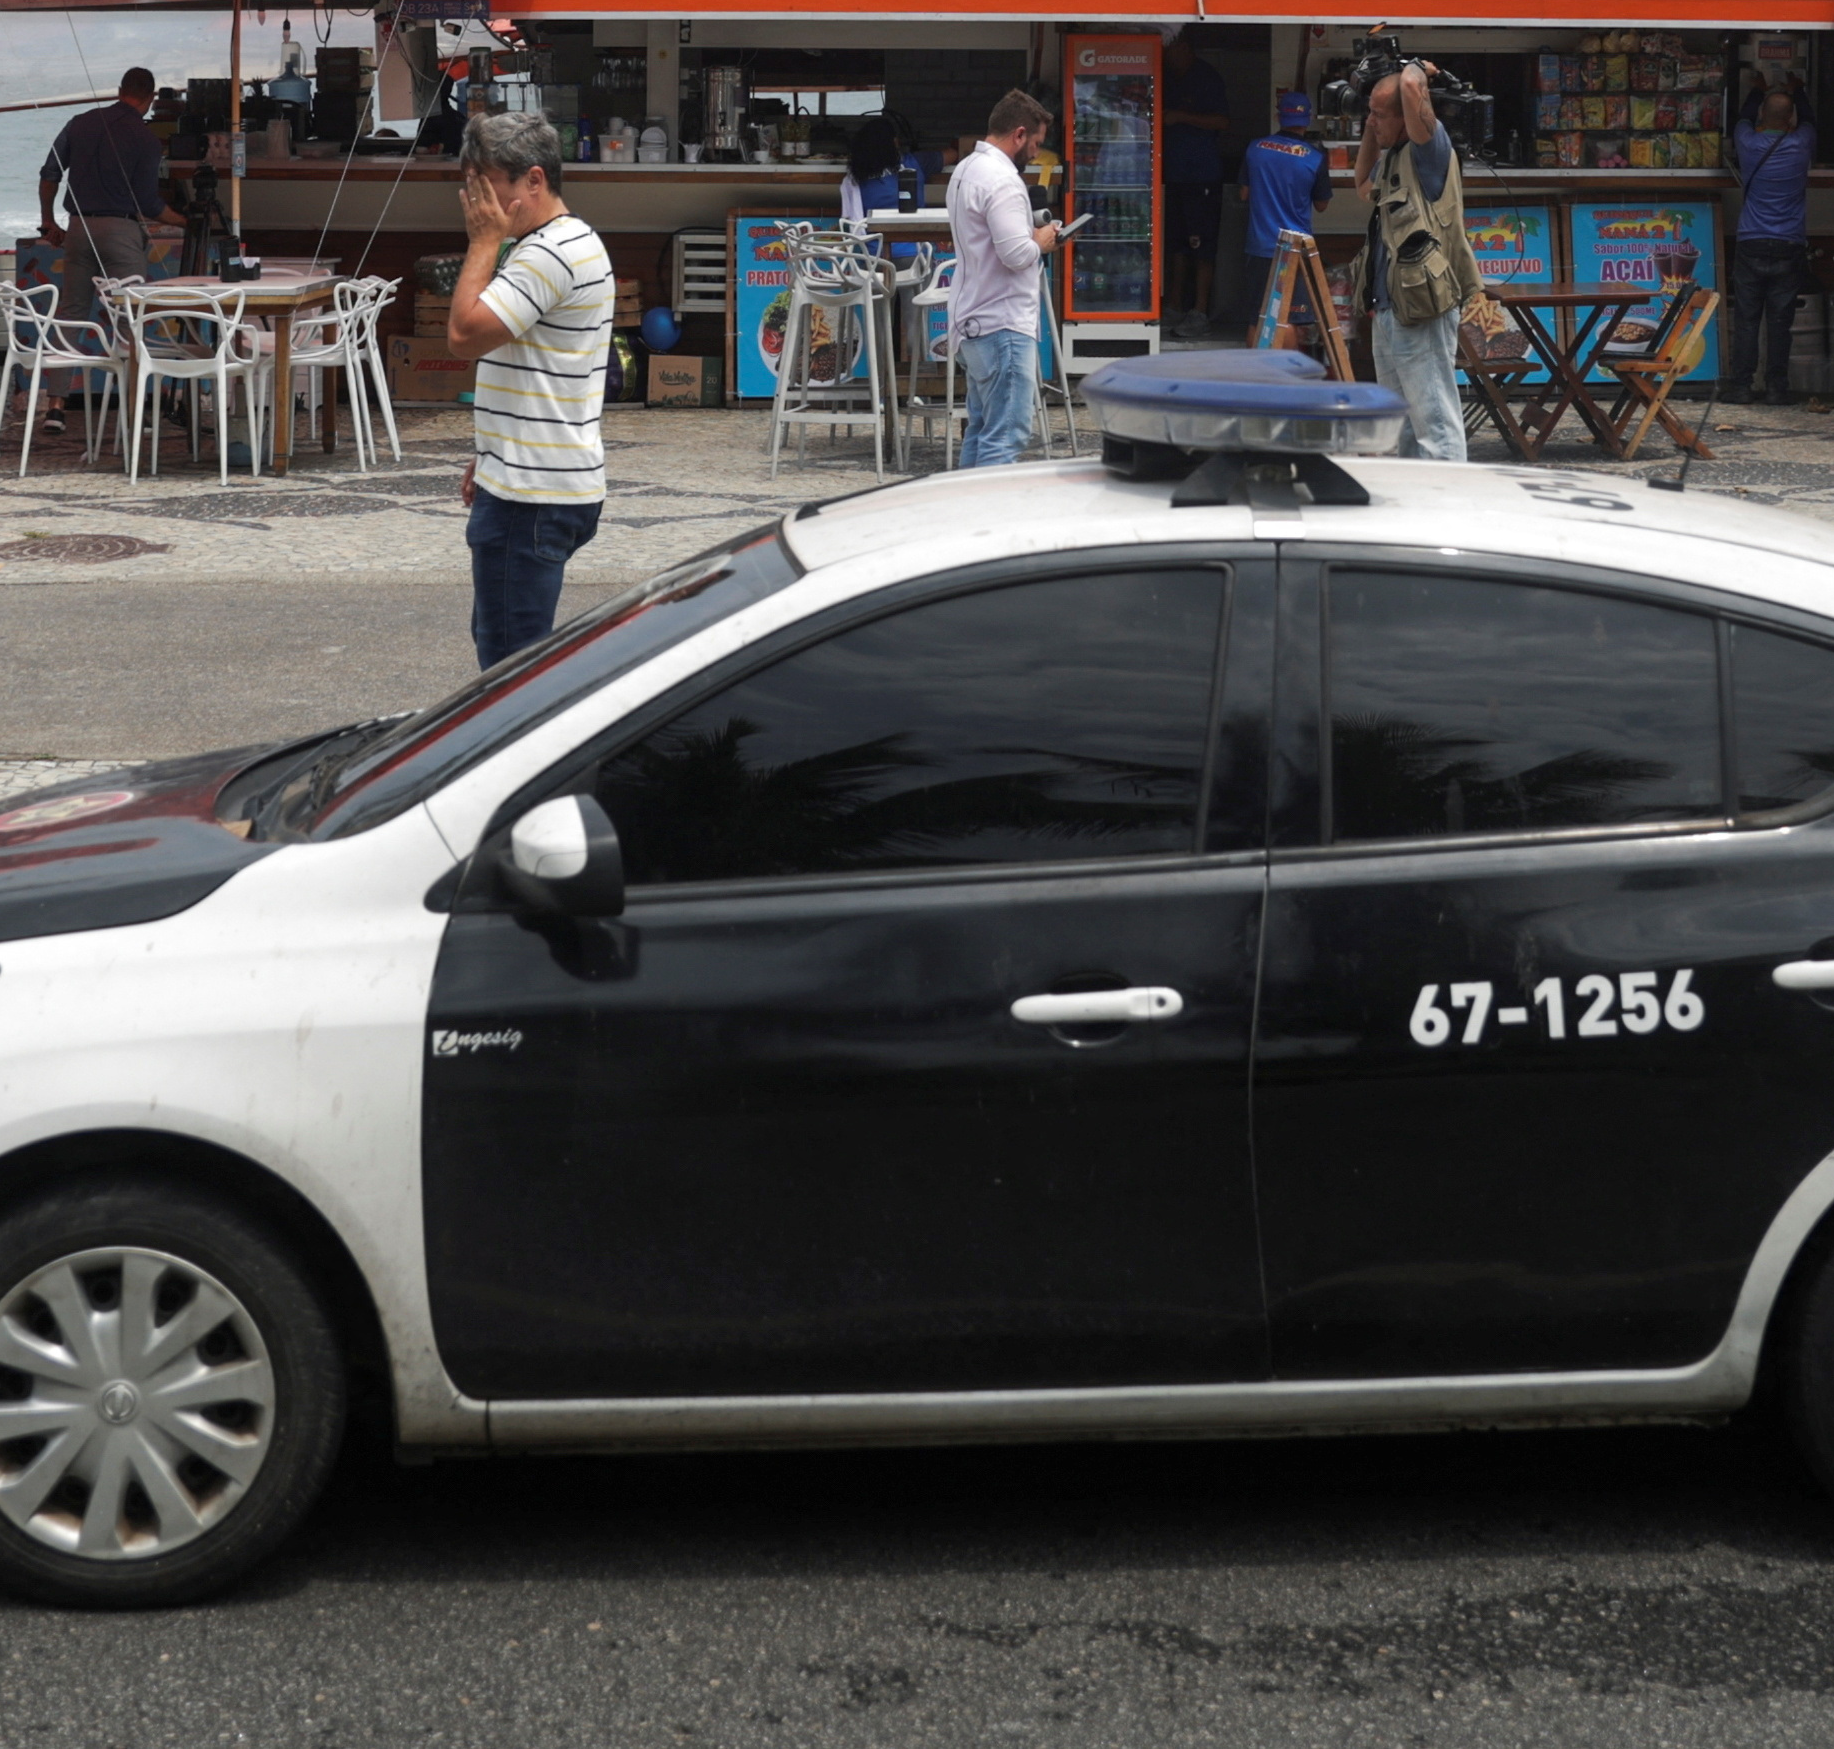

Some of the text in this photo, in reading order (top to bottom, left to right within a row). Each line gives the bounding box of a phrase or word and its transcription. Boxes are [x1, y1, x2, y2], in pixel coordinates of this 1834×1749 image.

[1079, 49, 1147, 67] G GATORADE
[1652, 225, 1665, 239] 2
[1489, 234, 1507, 250] 2
[1594, 243, 1624, 255] Sabor
[1601, 255, 1654, 282] AÇAÍ
[1409, 968, 1705, 1047] 67-1256
